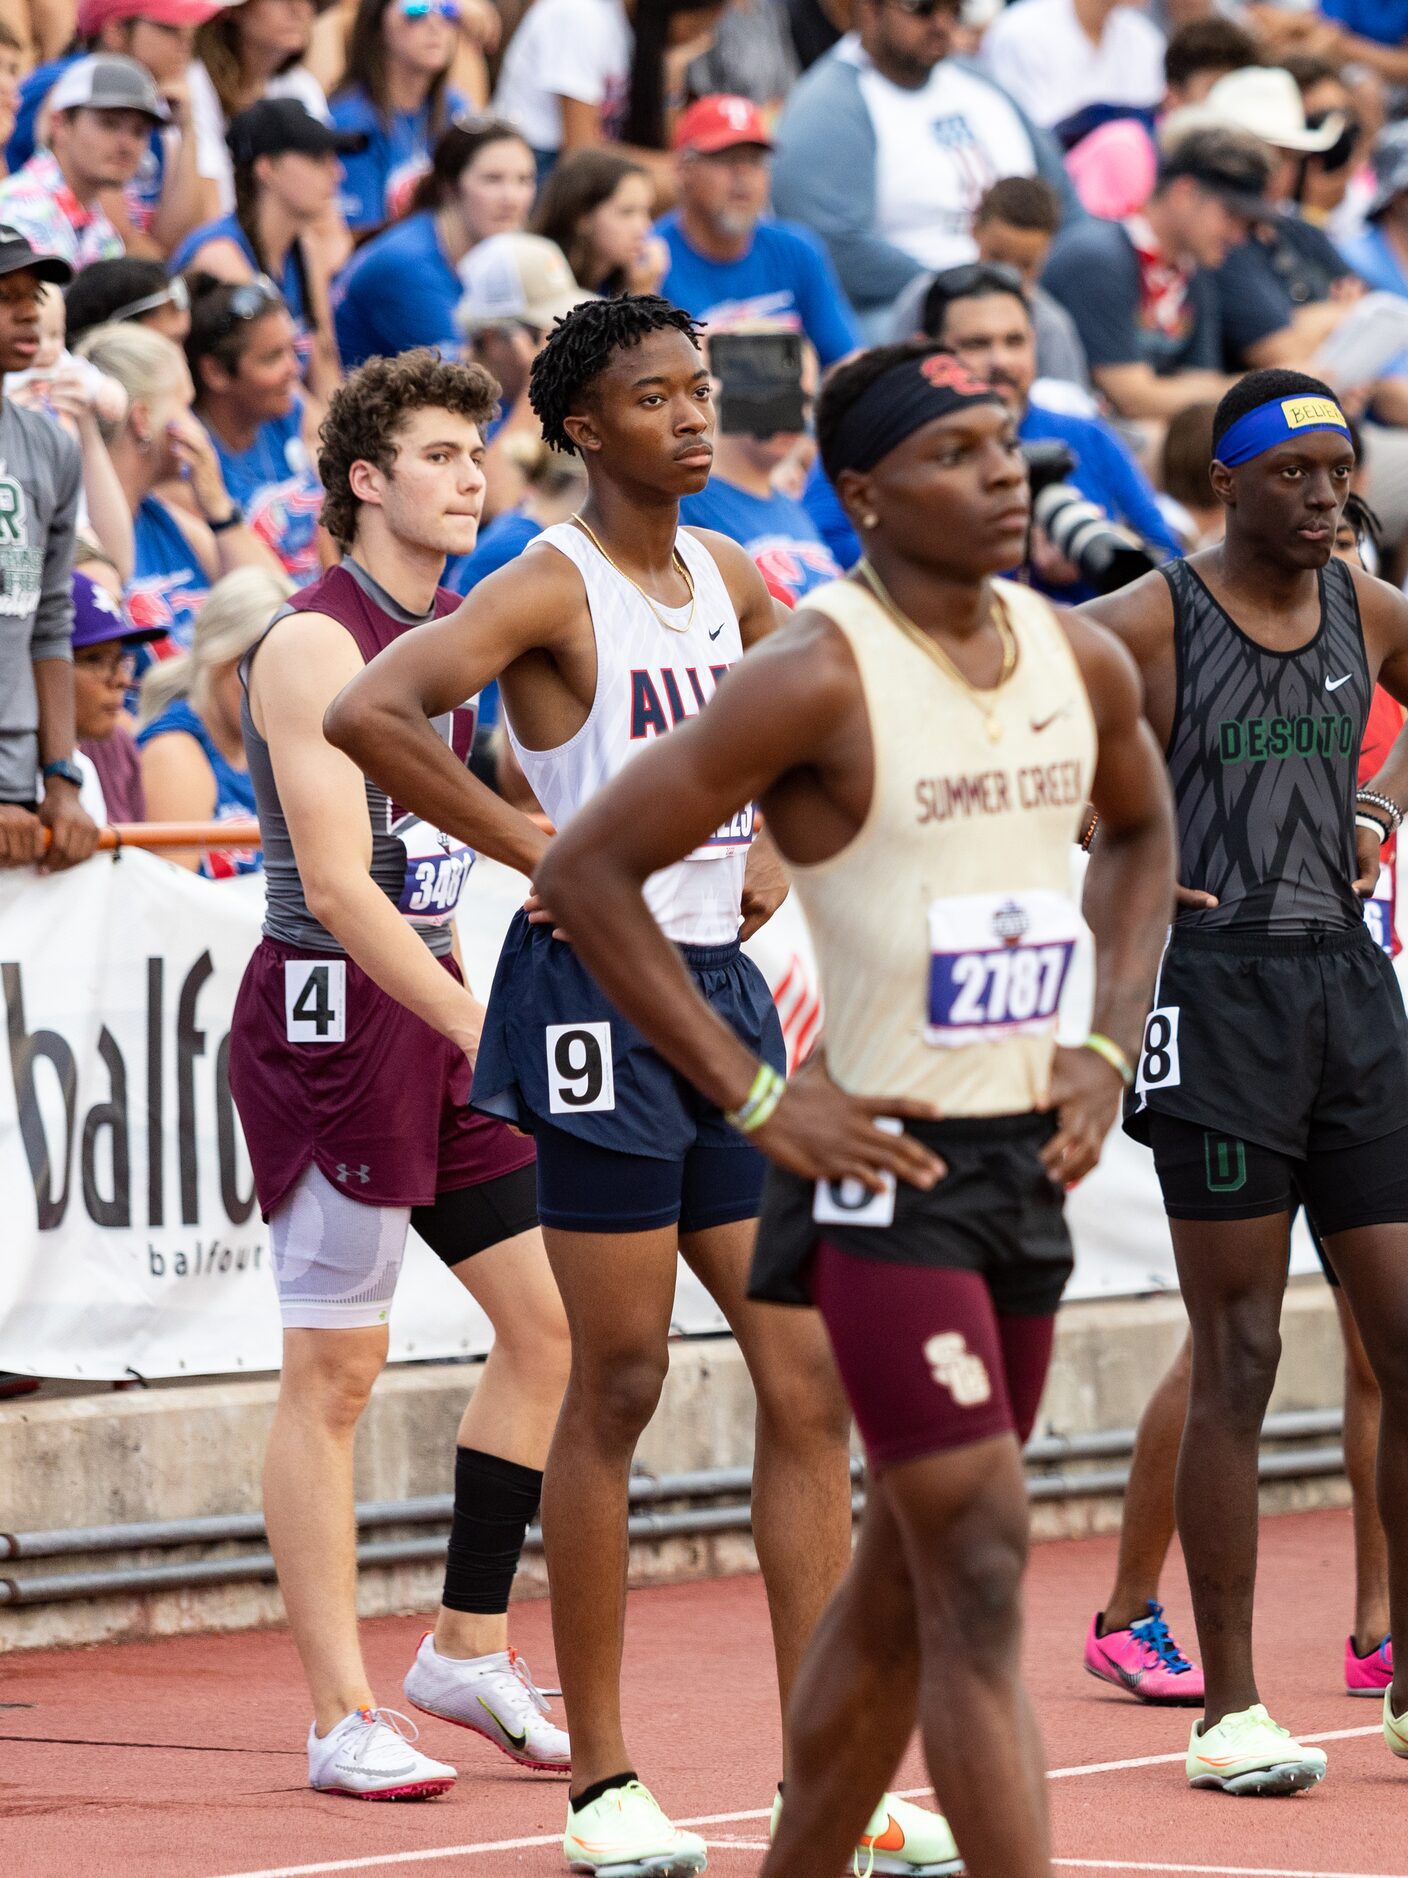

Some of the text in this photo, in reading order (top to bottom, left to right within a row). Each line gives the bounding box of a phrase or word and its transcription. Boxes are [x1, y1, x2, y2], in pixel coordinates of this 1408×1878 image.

[1291, 403, 1340, 424] BELIE
[1218, 713, 1353, 765] DESOTO
[916, 769, 1011, 825] SUMMER
[293, 966, 335, 1035] 4
[949, 948, 1067, 1025] 2787
[554, 1030, 603, 1106] 9
[1143, 1015, 1172, 1083] 8
[1204, 1131, 1247, 1192] D
